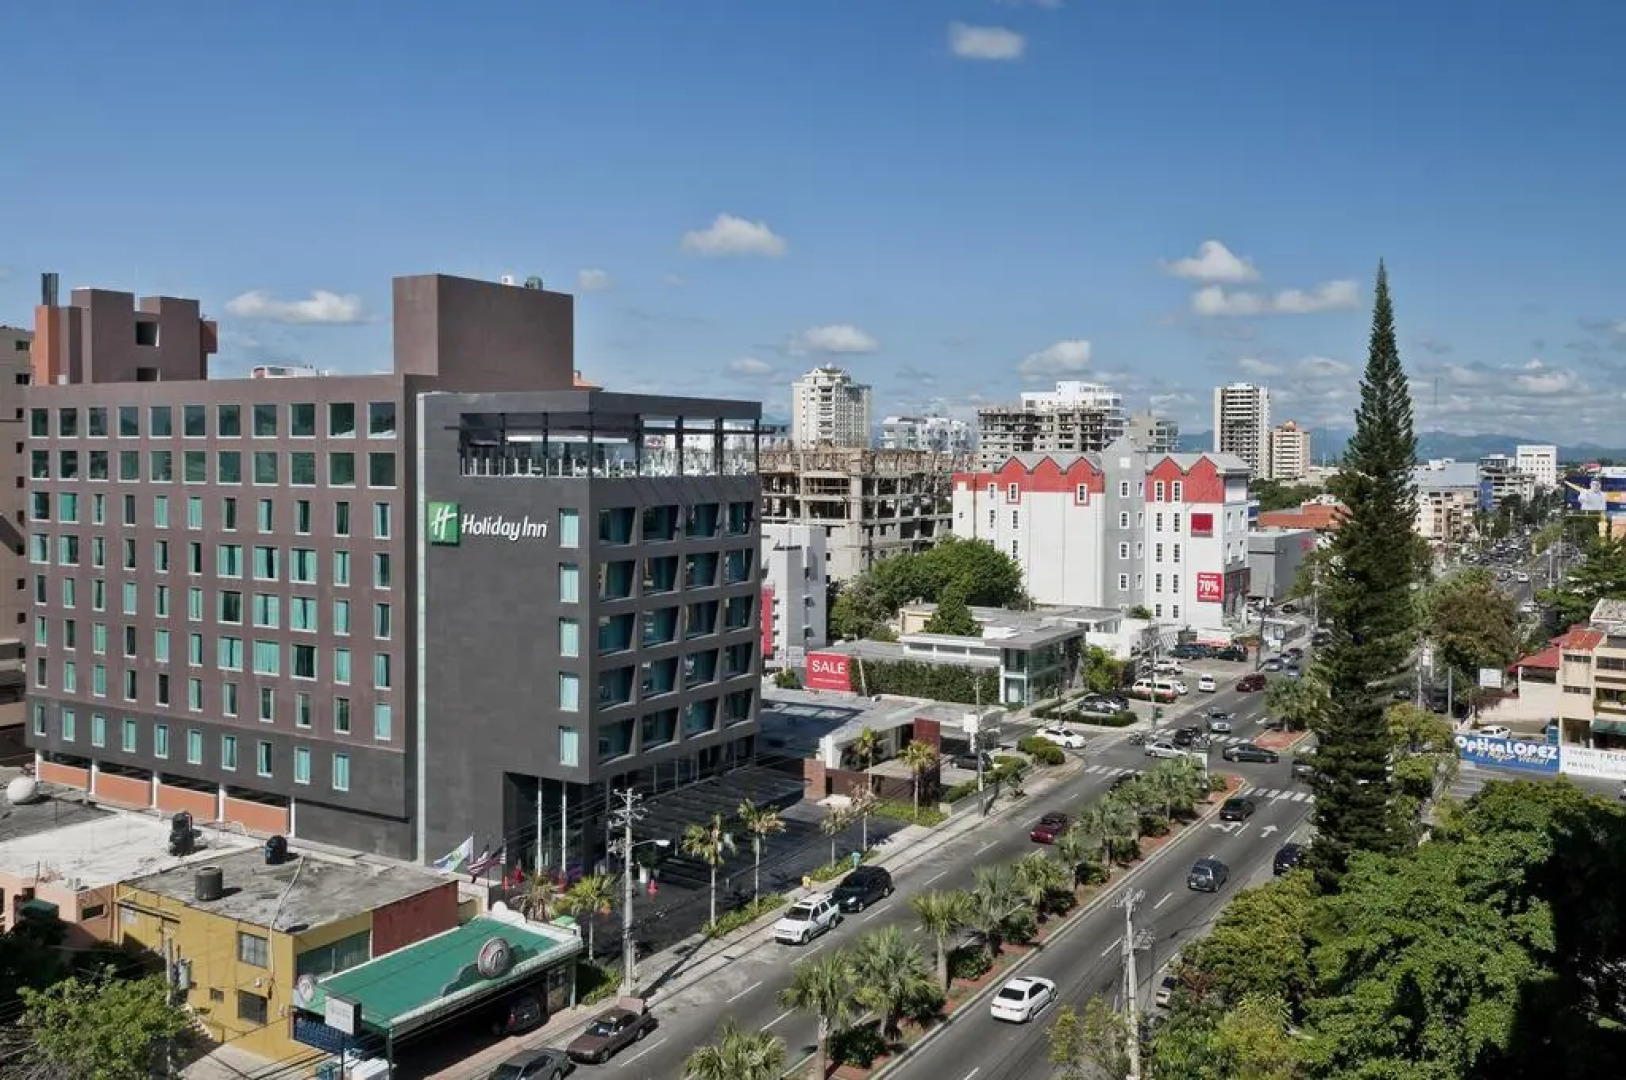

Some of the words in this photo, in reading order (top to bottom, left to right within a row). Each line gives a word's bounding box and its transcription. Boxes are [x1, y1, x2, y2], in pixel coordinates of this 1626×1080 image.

[461, 513, 520, 541] Holiday
[522, 516, 548, 538] Inn
[1199, 580, 1219, 592] 70%
[812, 660, 846, 675] SALE
